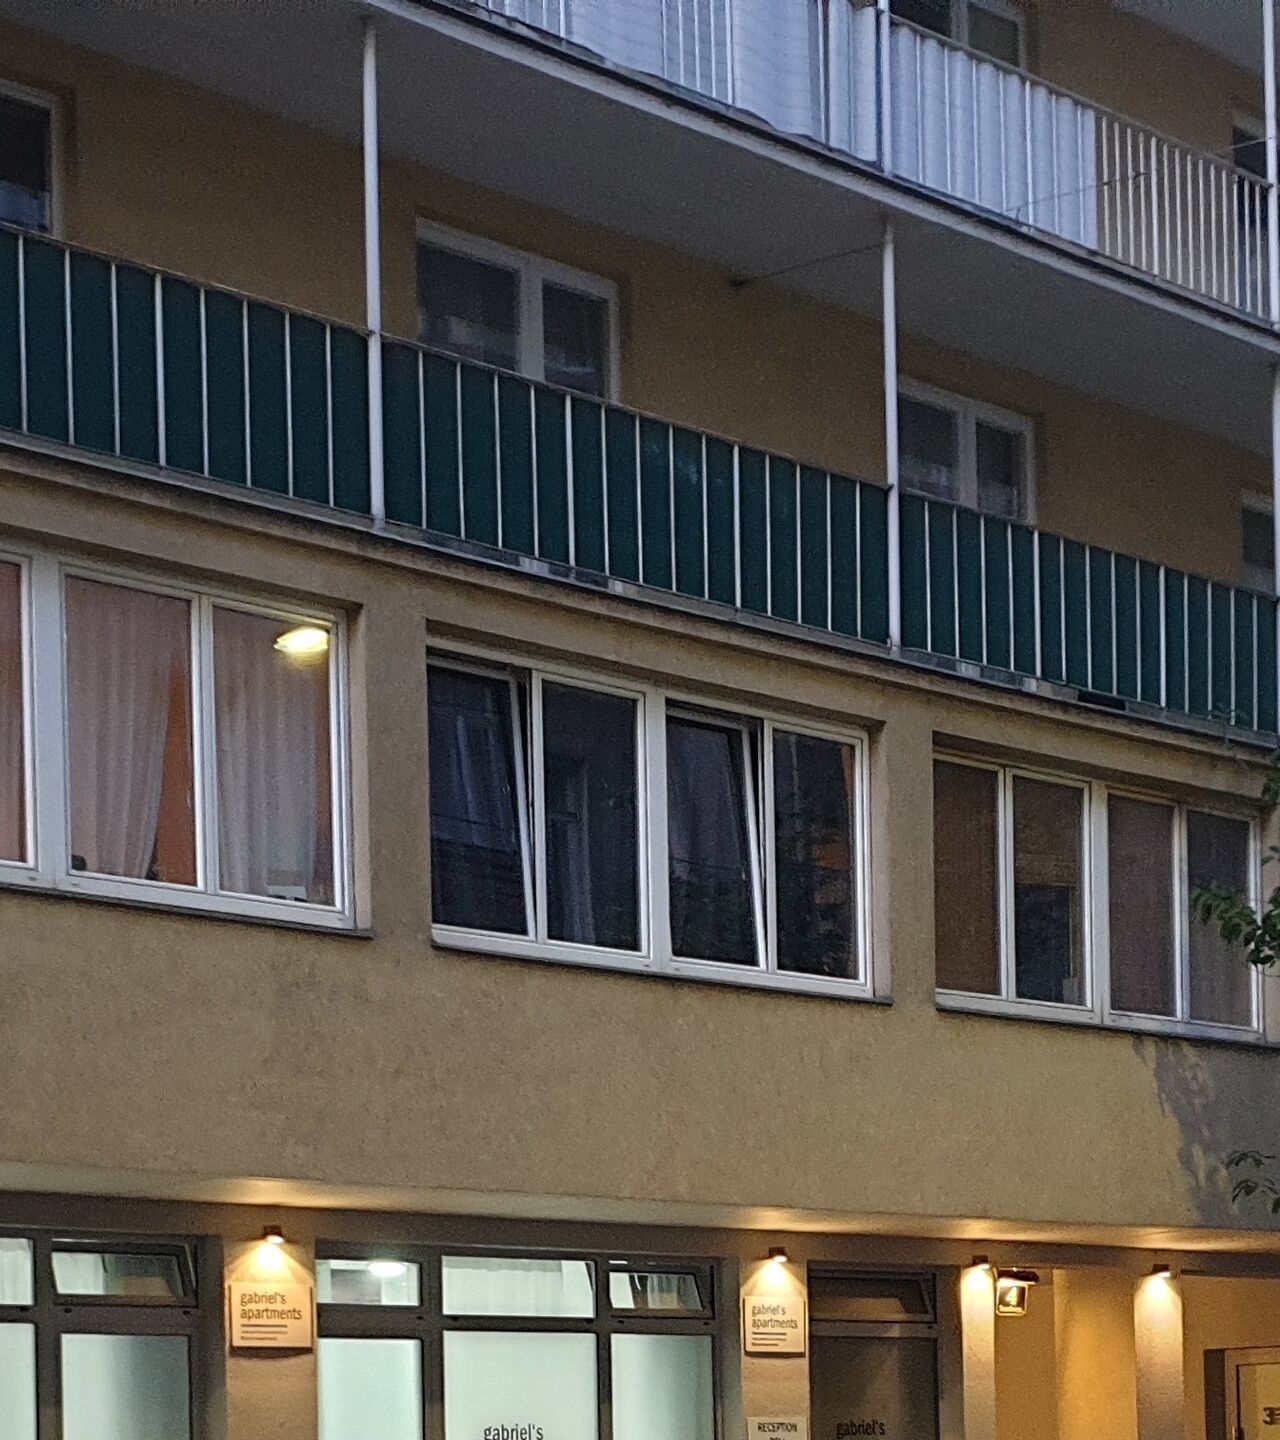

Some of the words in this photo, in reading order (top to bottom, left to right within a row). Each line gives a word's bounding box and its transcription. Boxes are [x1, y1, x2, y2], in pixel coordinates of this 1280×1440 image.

[240, 1291, 287, 1307] gabriel's
[1005, 1286, 1018, 1306] 4
[240, 1307, 303, 1321] apartments
[757, 1422, 798, 1433] RECEPTION
[836, 1419, 886, 1440] gabriel's
